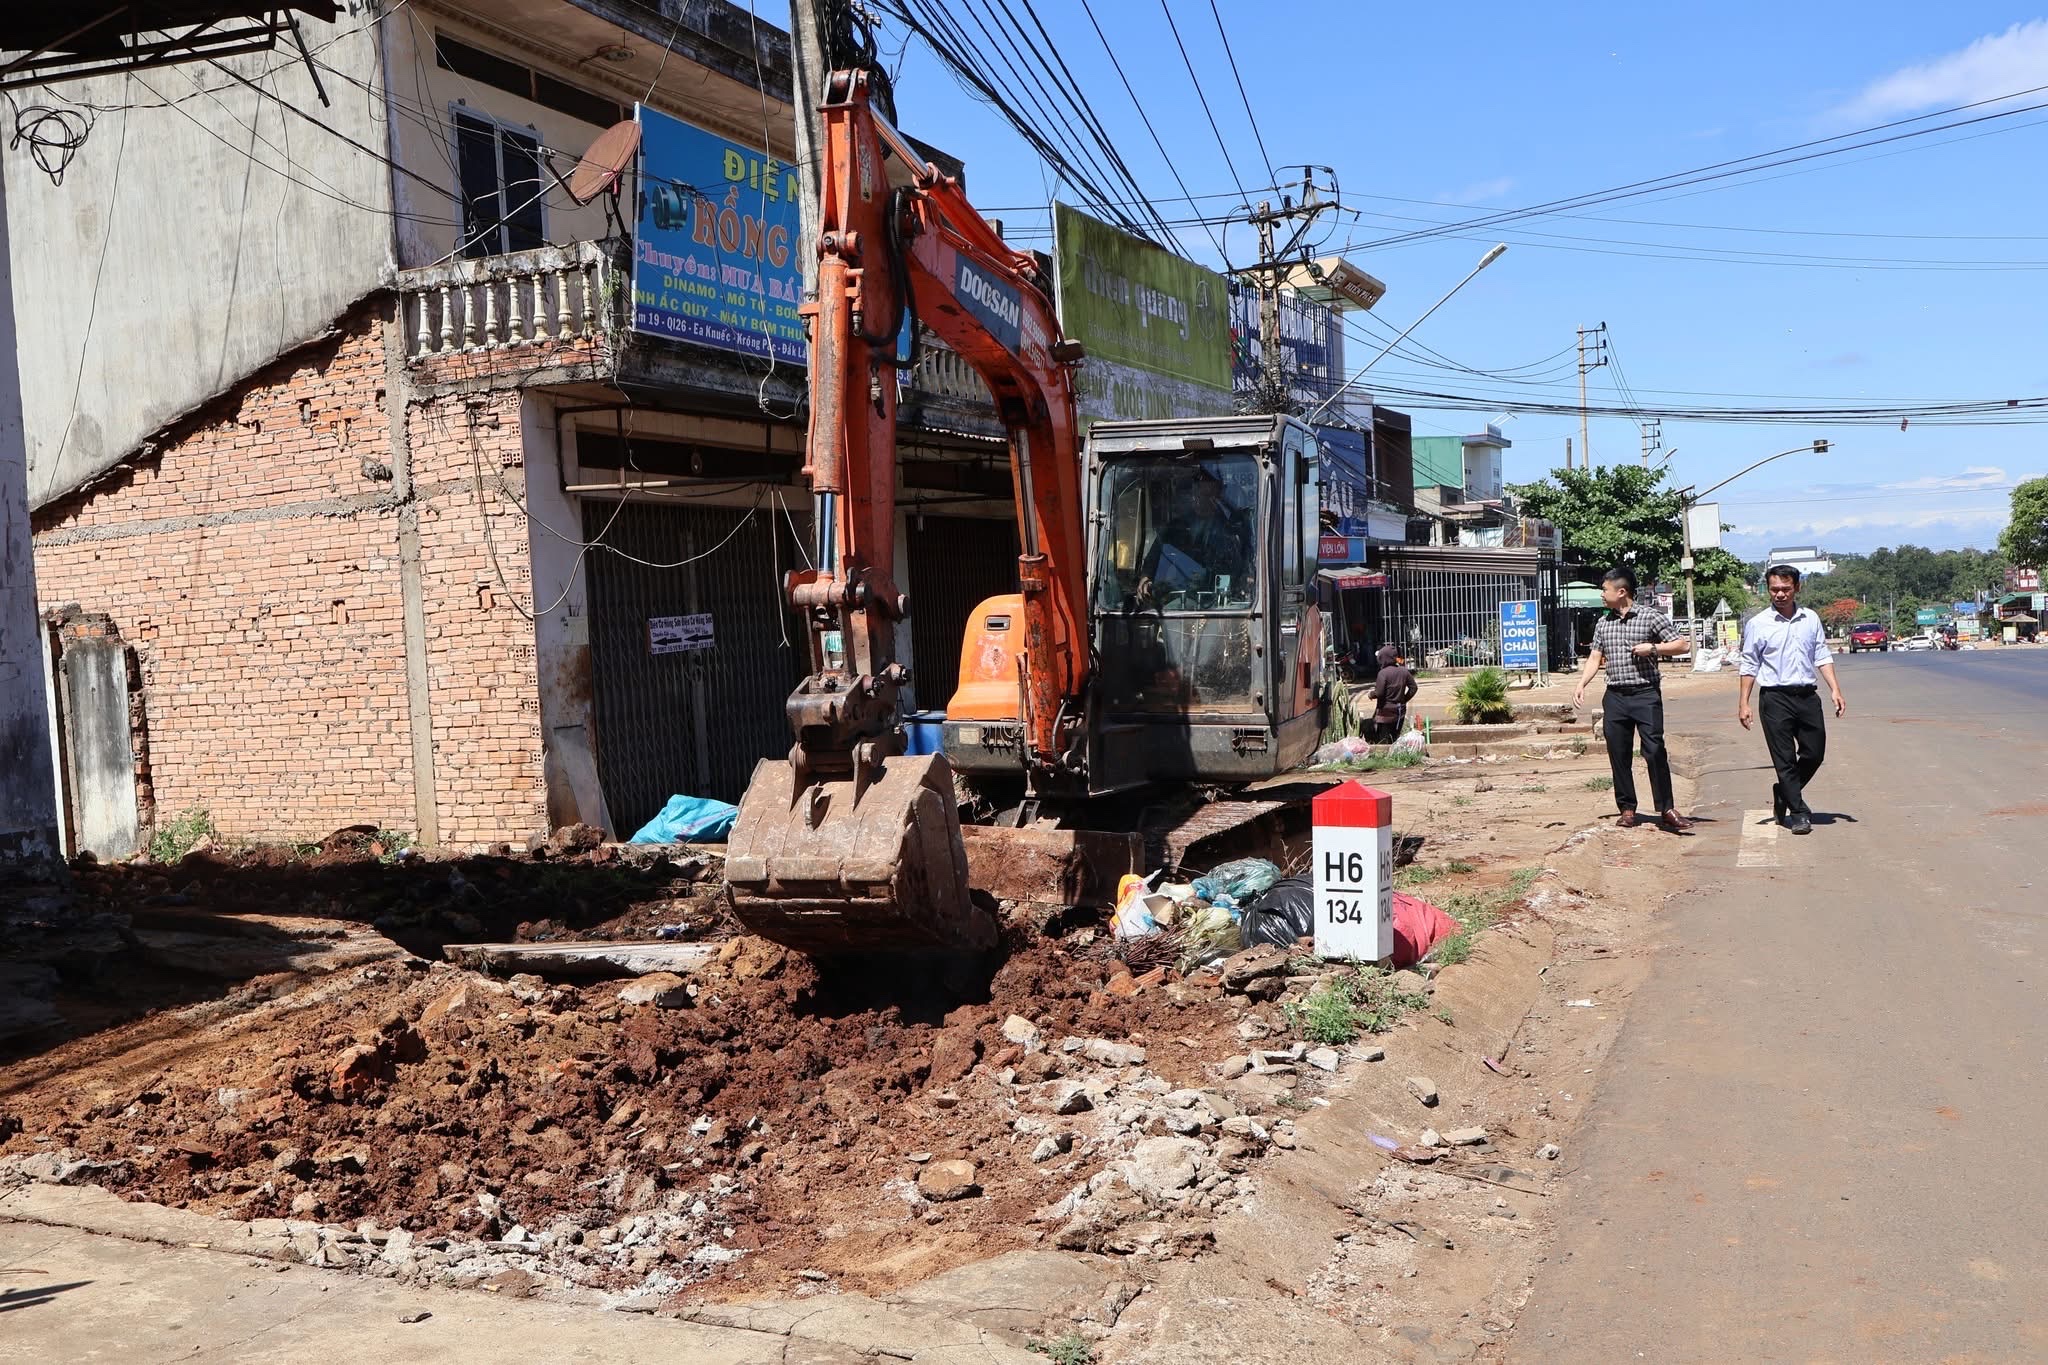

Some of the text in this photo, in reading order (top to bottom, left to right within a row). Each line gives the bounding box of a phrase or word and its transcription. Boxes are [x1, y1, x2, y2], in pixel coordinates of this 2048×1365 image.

[692, 185, 789, 268] HỒNG
[721, 264, 765, 295] MUA
[635, 290, 655, 305] NH
[659, 291, 679, 311] ẮC
[682, 301, 708, 318] QUY
[720, 310, 748, 327] MÁY
[751, 318, 776, 335] BƠM
[663, 275, 716, 300] DINAMO
[727, 291, 746, 307] MÔ
[776, 304, 801, 322] BƠM
[960, 265, 1020, 329] DOOSAN
[648, 312, 660, 326] 19
[693, 322, 704, 336] Ea
[1503, 627, 1536, 638] LONG
[1504, 639, 1537, 652] CHÂU
[1325, 851, 1363, 883] H6
[1380, 850, 1391, 882] H6
[1326, 899, 1363, 925] 134
[1380, 898, 1391, 923] 134
